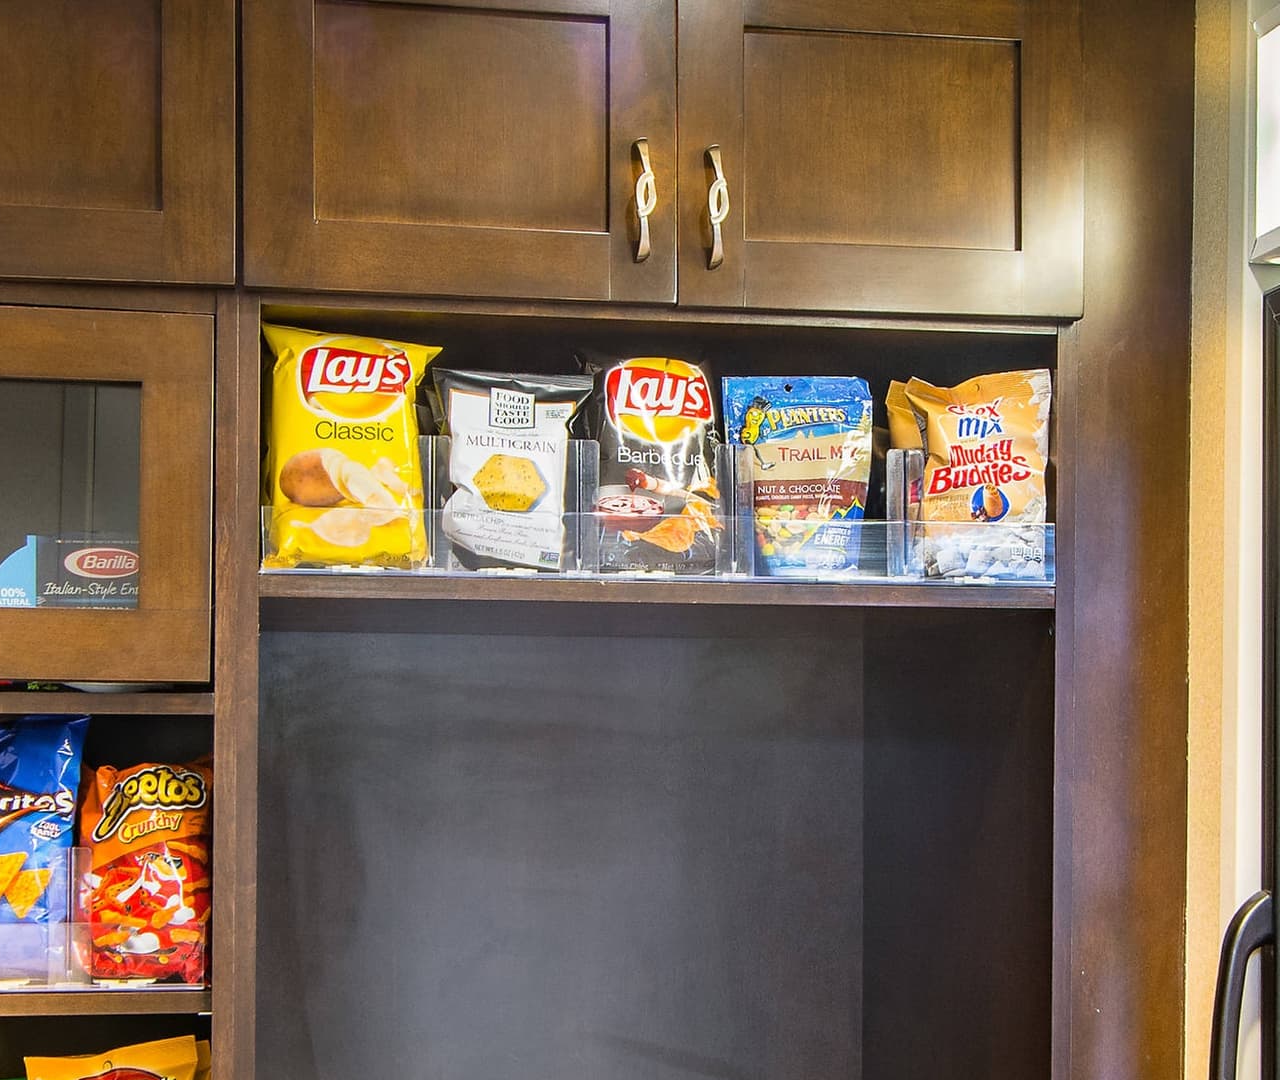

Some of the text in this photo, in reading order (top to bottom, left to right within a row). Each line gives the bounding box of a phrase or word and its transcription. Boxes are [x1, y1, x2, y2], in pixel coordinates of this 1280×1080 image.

[307, 347, 408, 394] Lay's
[496, 392, 530, 405] FOOD
[618, 367, 705, 416] Lay's
[495, 402, 530, 410] SHOULD
[496, 408, 529, 417] TASTE
[495, 417, 529, 425] GOOD
[767, 407, 846, 430] PLANTERS
[314, 420, 394, 443] Classic
[466, 435, 556, 453] MULTIGRAIN
[778, 447, 826, 462] TRAIL
[950, 439, 1013, 467] Muddy
[928, 456, 1031, 494] Buddies
[758, 484, 840, 494] NUT & CHOCOLATE
[82, 554, 136, 570] Barilla
[44, 581, 117, 597] Italian-Style
[119, 812, 183, 843] Crunchy
